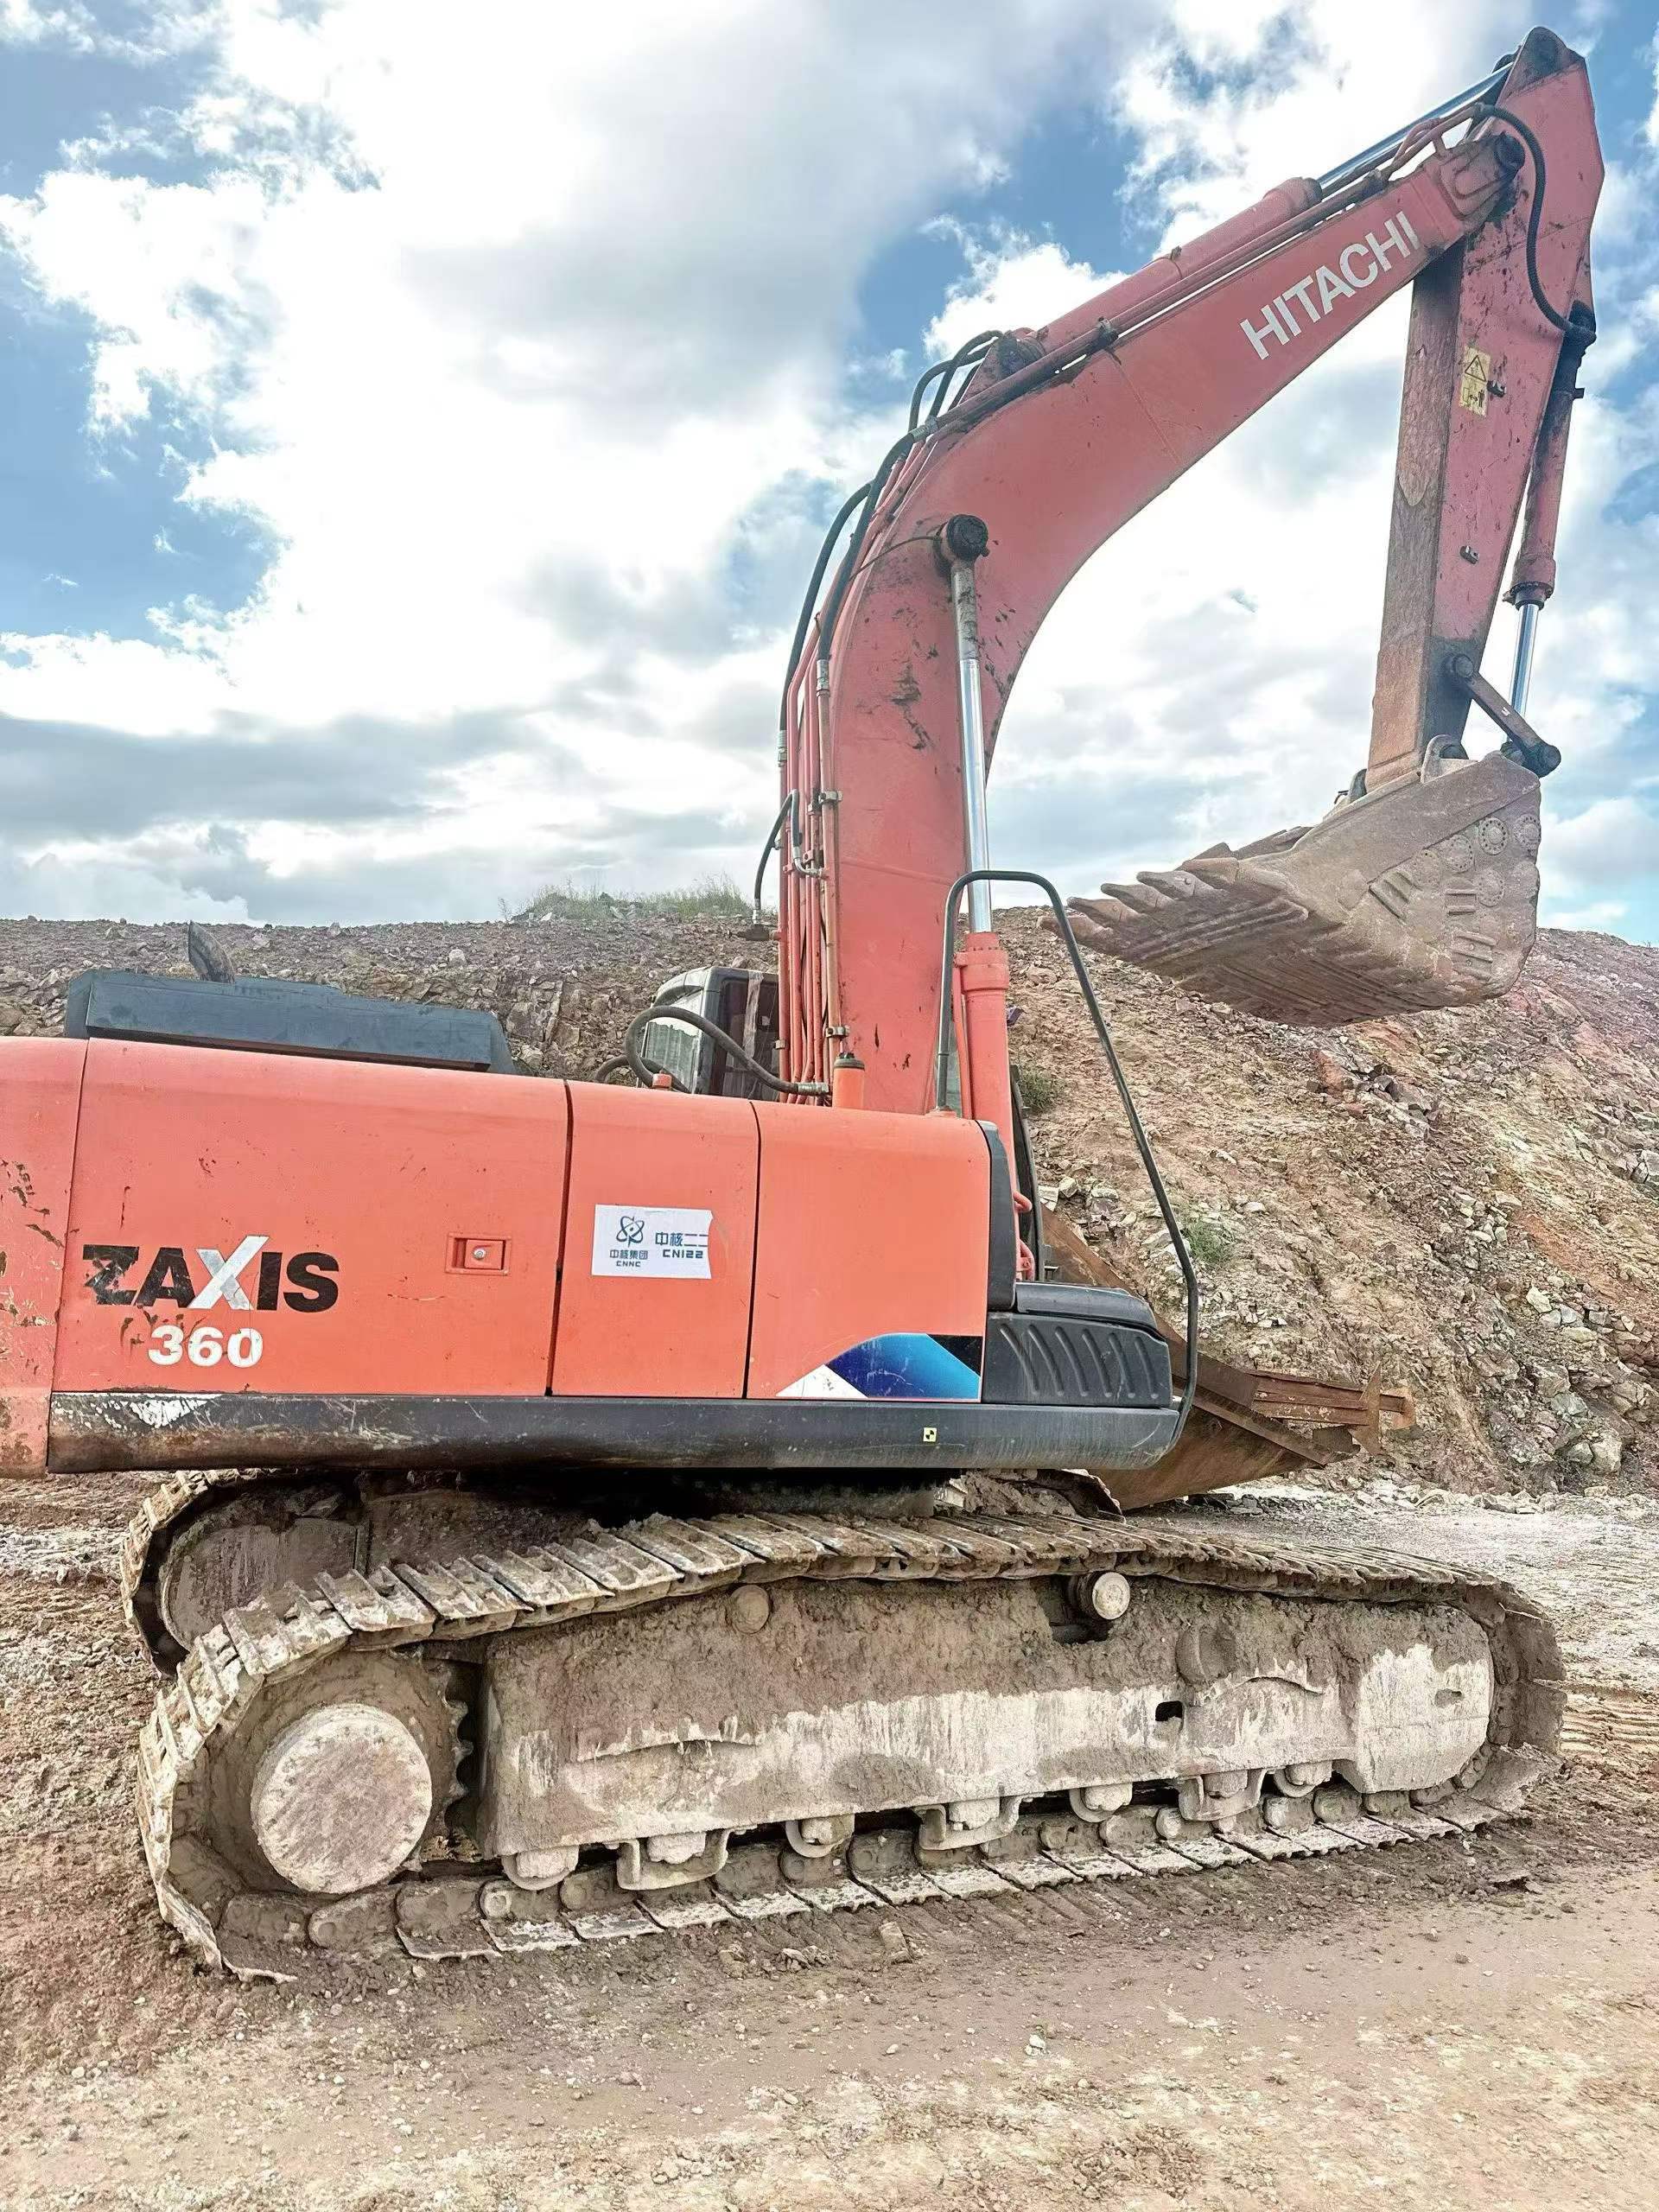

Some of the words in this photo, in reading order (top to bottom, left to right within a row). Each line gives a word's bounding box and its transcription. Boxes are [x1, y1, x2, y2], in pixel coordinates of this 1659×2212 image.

[1240, 211, 1420, 359] HITACHI
[655, 1232, 709, 1247] 中核二二
[83, 1235, 340, 1313] ZAXIS
[148, 1325, 264, 1368] 360
